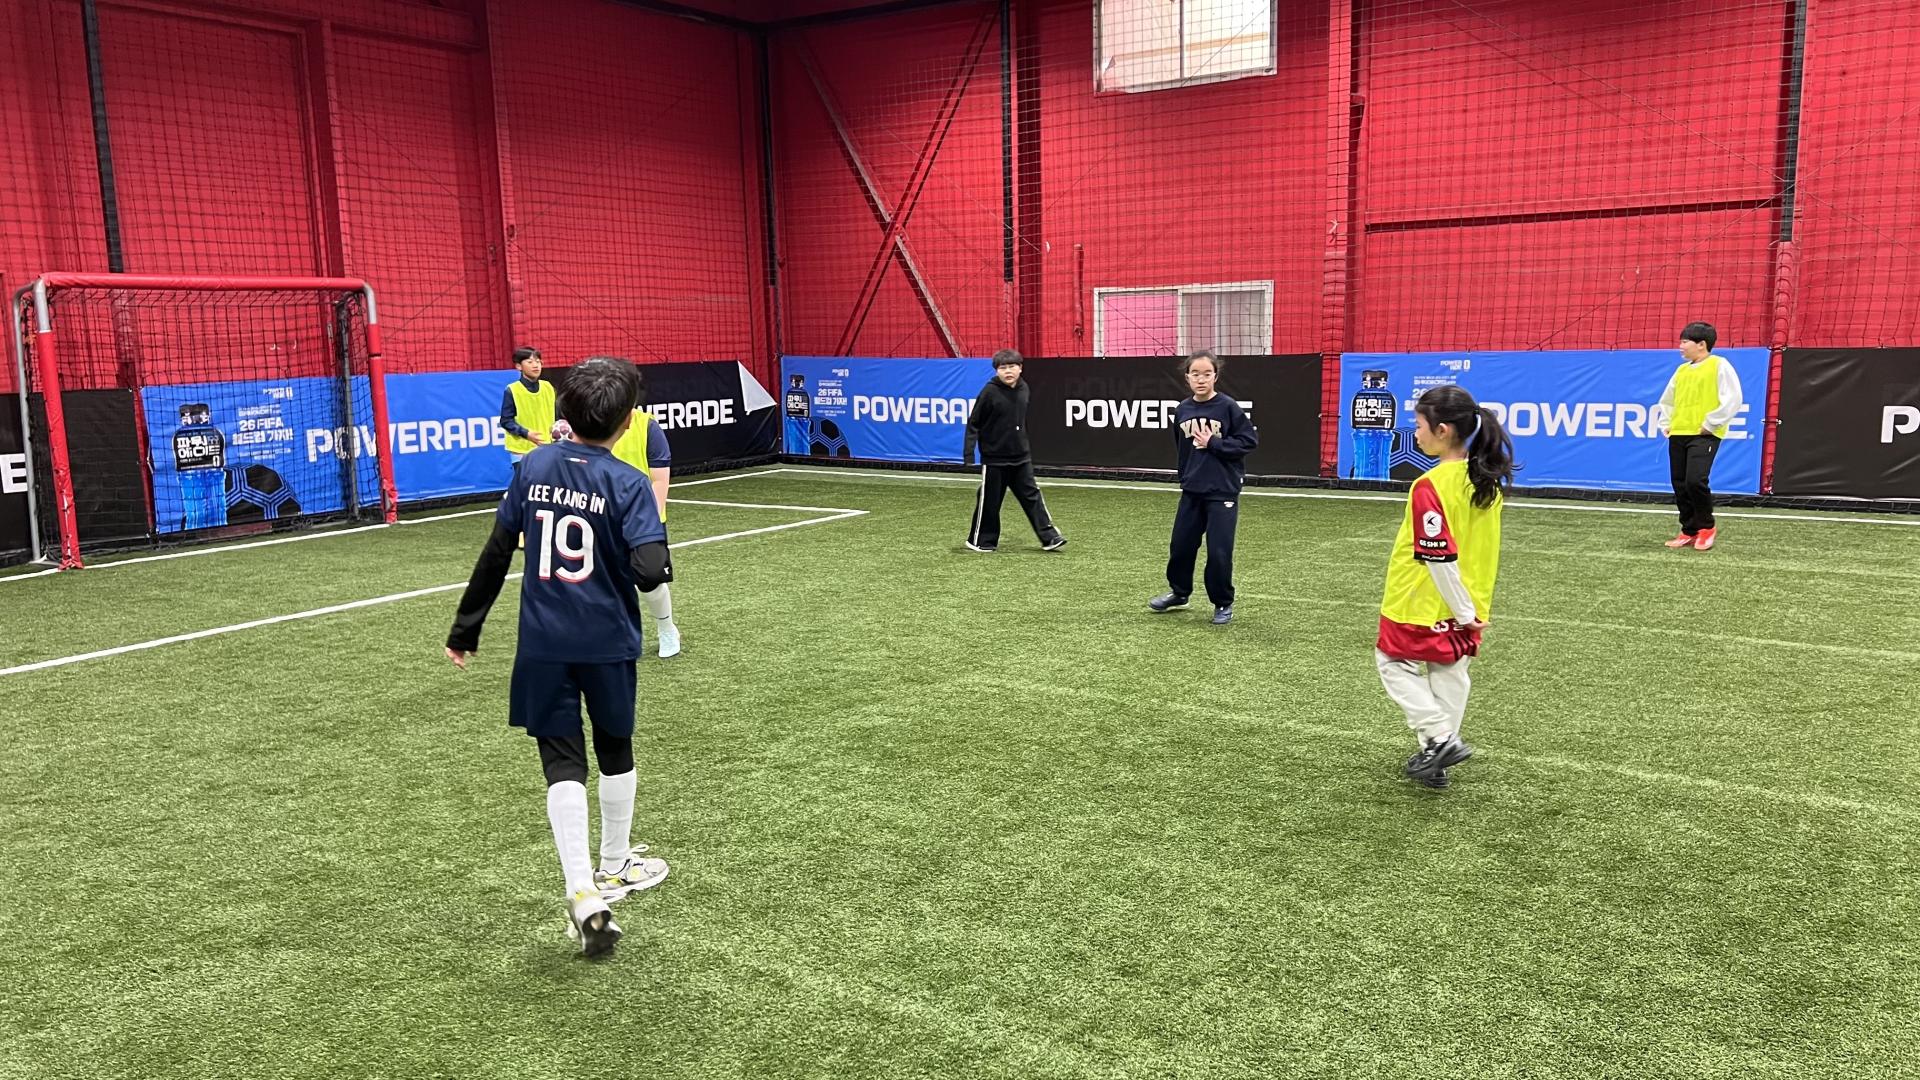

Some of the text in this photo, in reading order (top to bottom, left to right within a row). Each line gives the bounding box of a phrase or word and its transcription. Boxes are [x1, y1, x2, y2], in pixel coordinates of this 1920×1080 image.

[1355, 398, 1381, 408] 파워
[1355, 408, 1392, 418] 에이드
[239, 417, 284, 431] 26 FIFA
[177, 445, 220, 459] 에이드
[528, 484, 551, 503] LEE
[552, 486, 588, 510] KANG
[535, 509, 594, 584] 19
